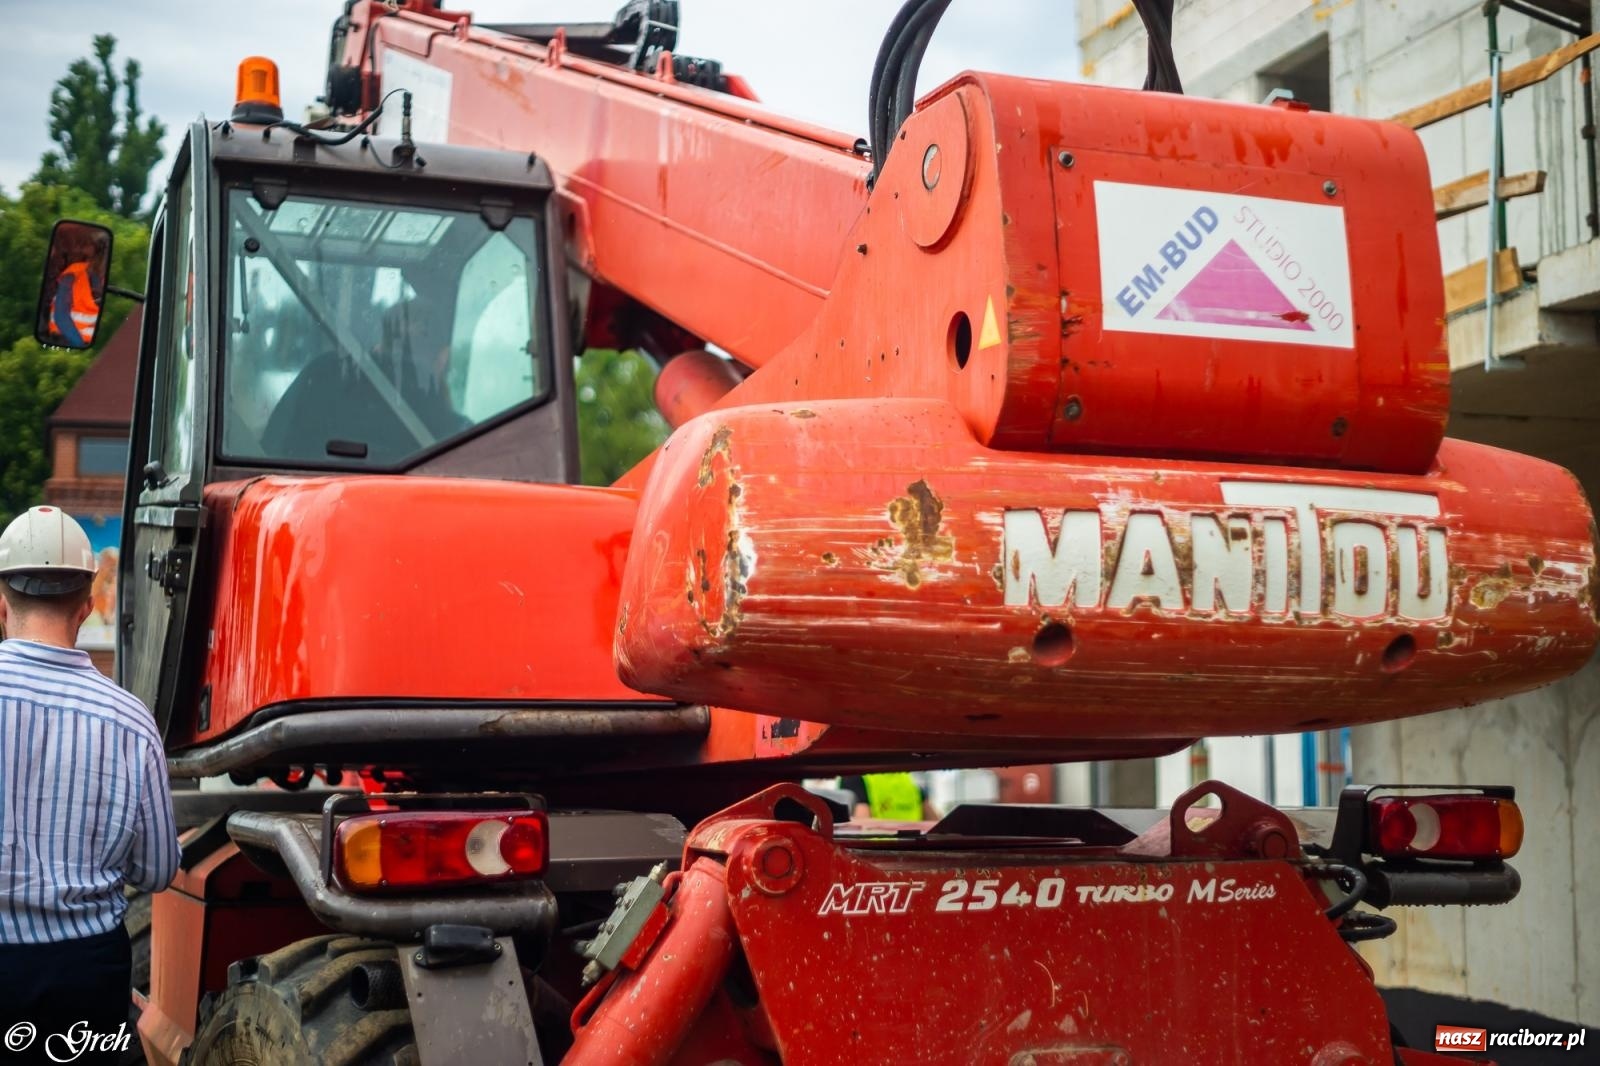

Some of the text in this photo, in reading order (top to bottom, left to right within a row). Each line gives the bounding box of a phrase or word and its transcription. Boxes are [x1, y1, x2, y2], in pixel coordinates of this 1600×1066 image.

[1115, 205, 1219, 317] EM-BUD
[1233, 206, 1344, 332] STUDIO 2000
[1003, 480, 1448, 620] MANITOU
[817, 881, 927, 915] MRT
[935, 878, 1066, 912] 2540
[1075, 883, 1174, 904] TURBO
